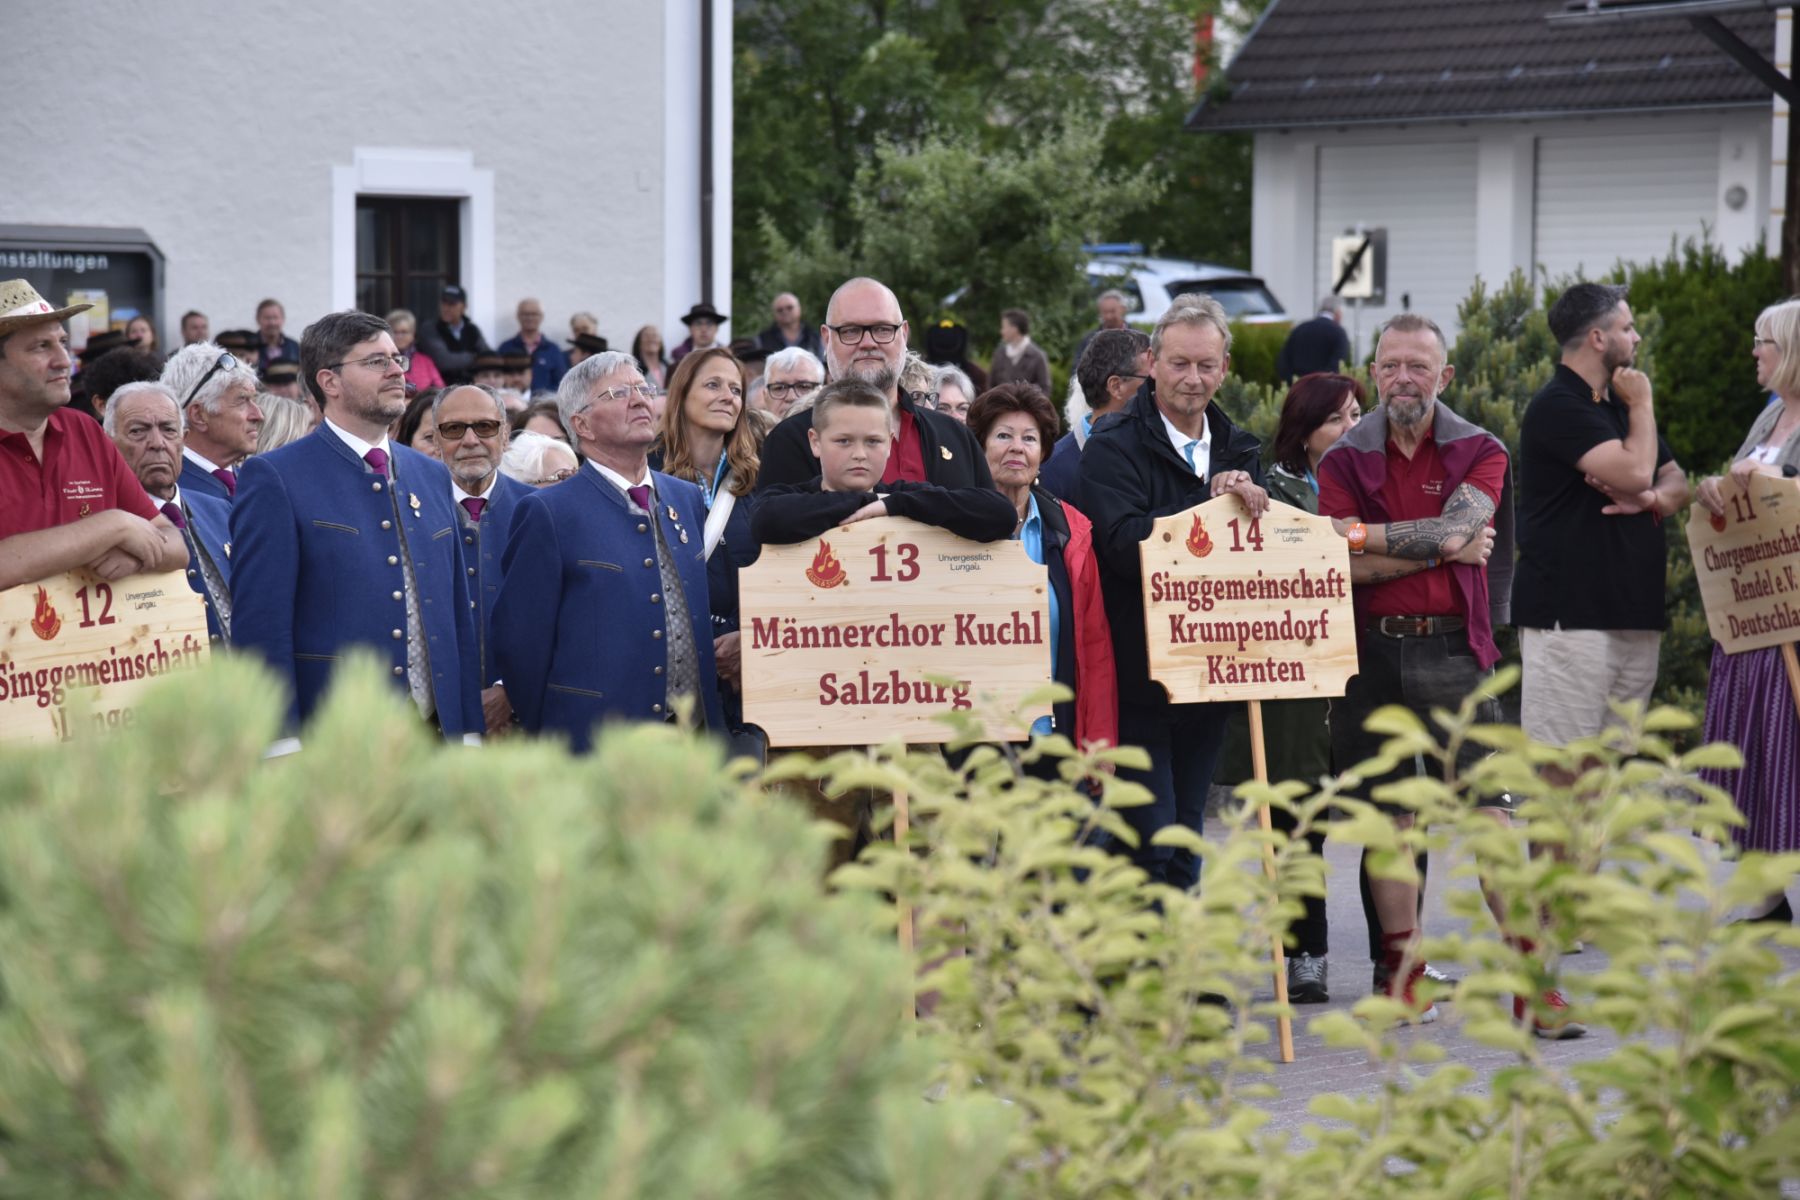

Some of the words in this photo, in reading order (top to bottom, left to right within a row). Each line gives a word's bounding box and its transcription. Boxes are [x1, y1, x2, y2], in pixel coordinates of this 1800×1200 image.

[1731, 490, 1757, 523] 11
[1227, 517, 1264, 552] 14
[869, 543, 921, 582] 13
[1151, 567, 1347, 613] Singgemeinschaft
[1731, 568, 1775, 602] Rendel
[1776, 565, 1799, 593] e.V.
[76, 582, 116, 628] 12
[1728, 602, 1800, 639] Deutschla
[751, 613, 946, 649] Männerchor
[953, 610, 1043, 647] Kuchl
[1168, 608, 1330, 652] Krumpendorf
[0, 634, 202, 708] Singgemeinschaft
[1206, 655, 1306, 685] Kärnten
[819, 670, 973, 712] Salzburg
